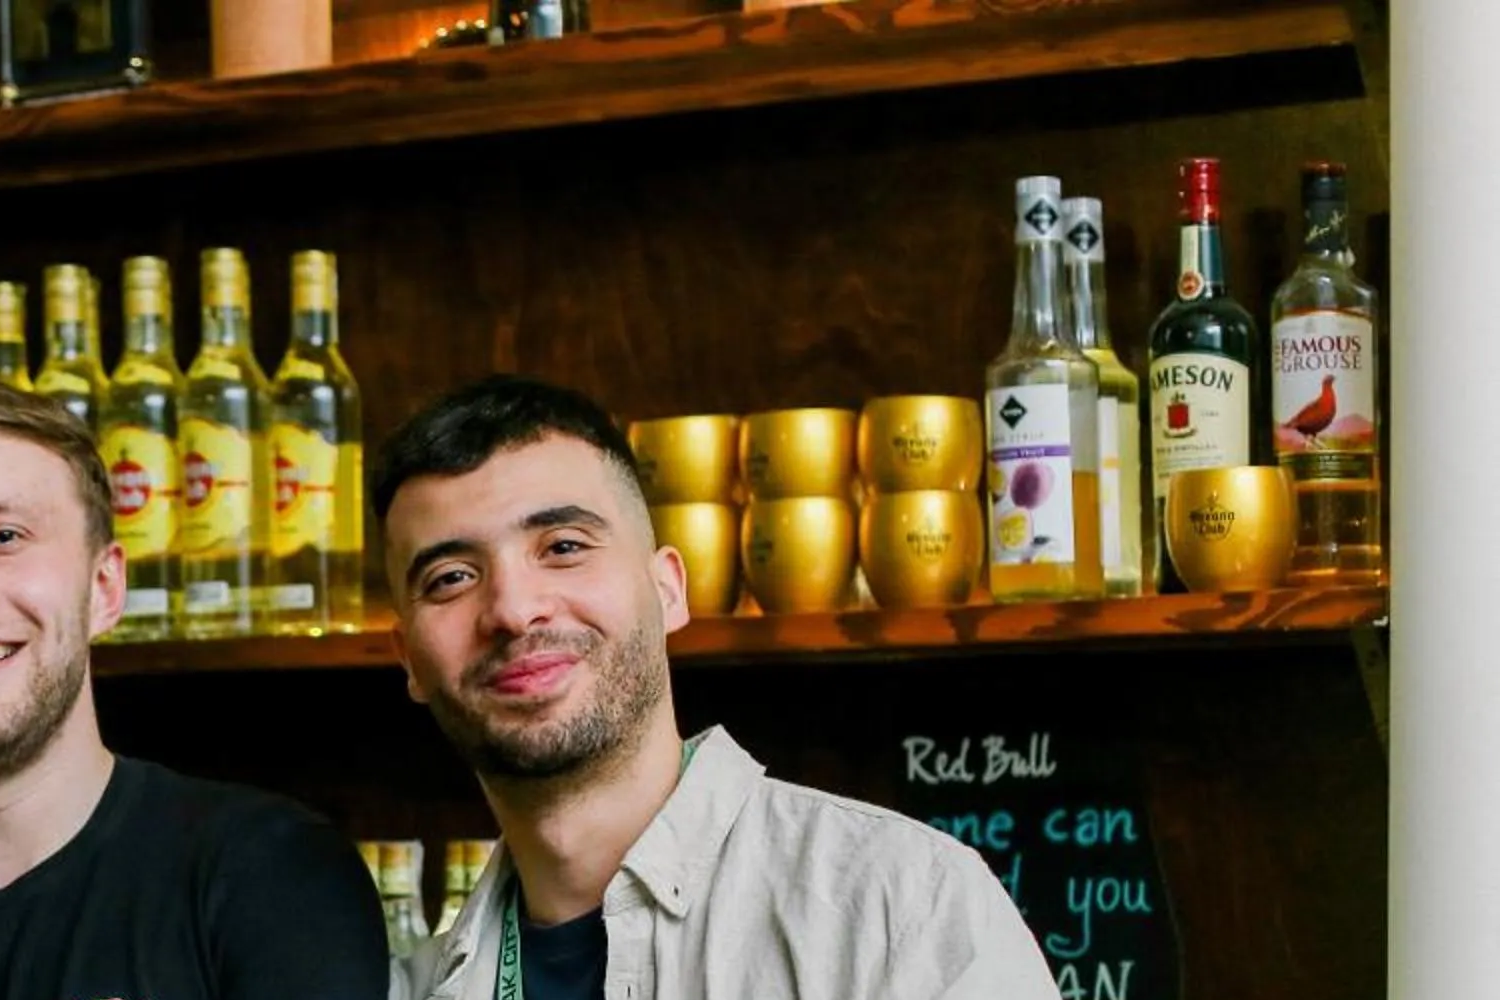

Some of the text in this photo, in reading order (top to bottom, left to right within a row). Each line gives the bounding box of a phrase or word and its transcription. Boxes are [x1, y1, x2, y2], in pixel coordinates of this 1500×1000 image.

[1281, 335, 1362, 356] FAMOUS
[1281, 353, 1362, 373] GROUSE
[903, 732, 1057, 784] Red Bull
[1043, 807, 1138, 846] can
[1045, 876, 1152, 957] you
